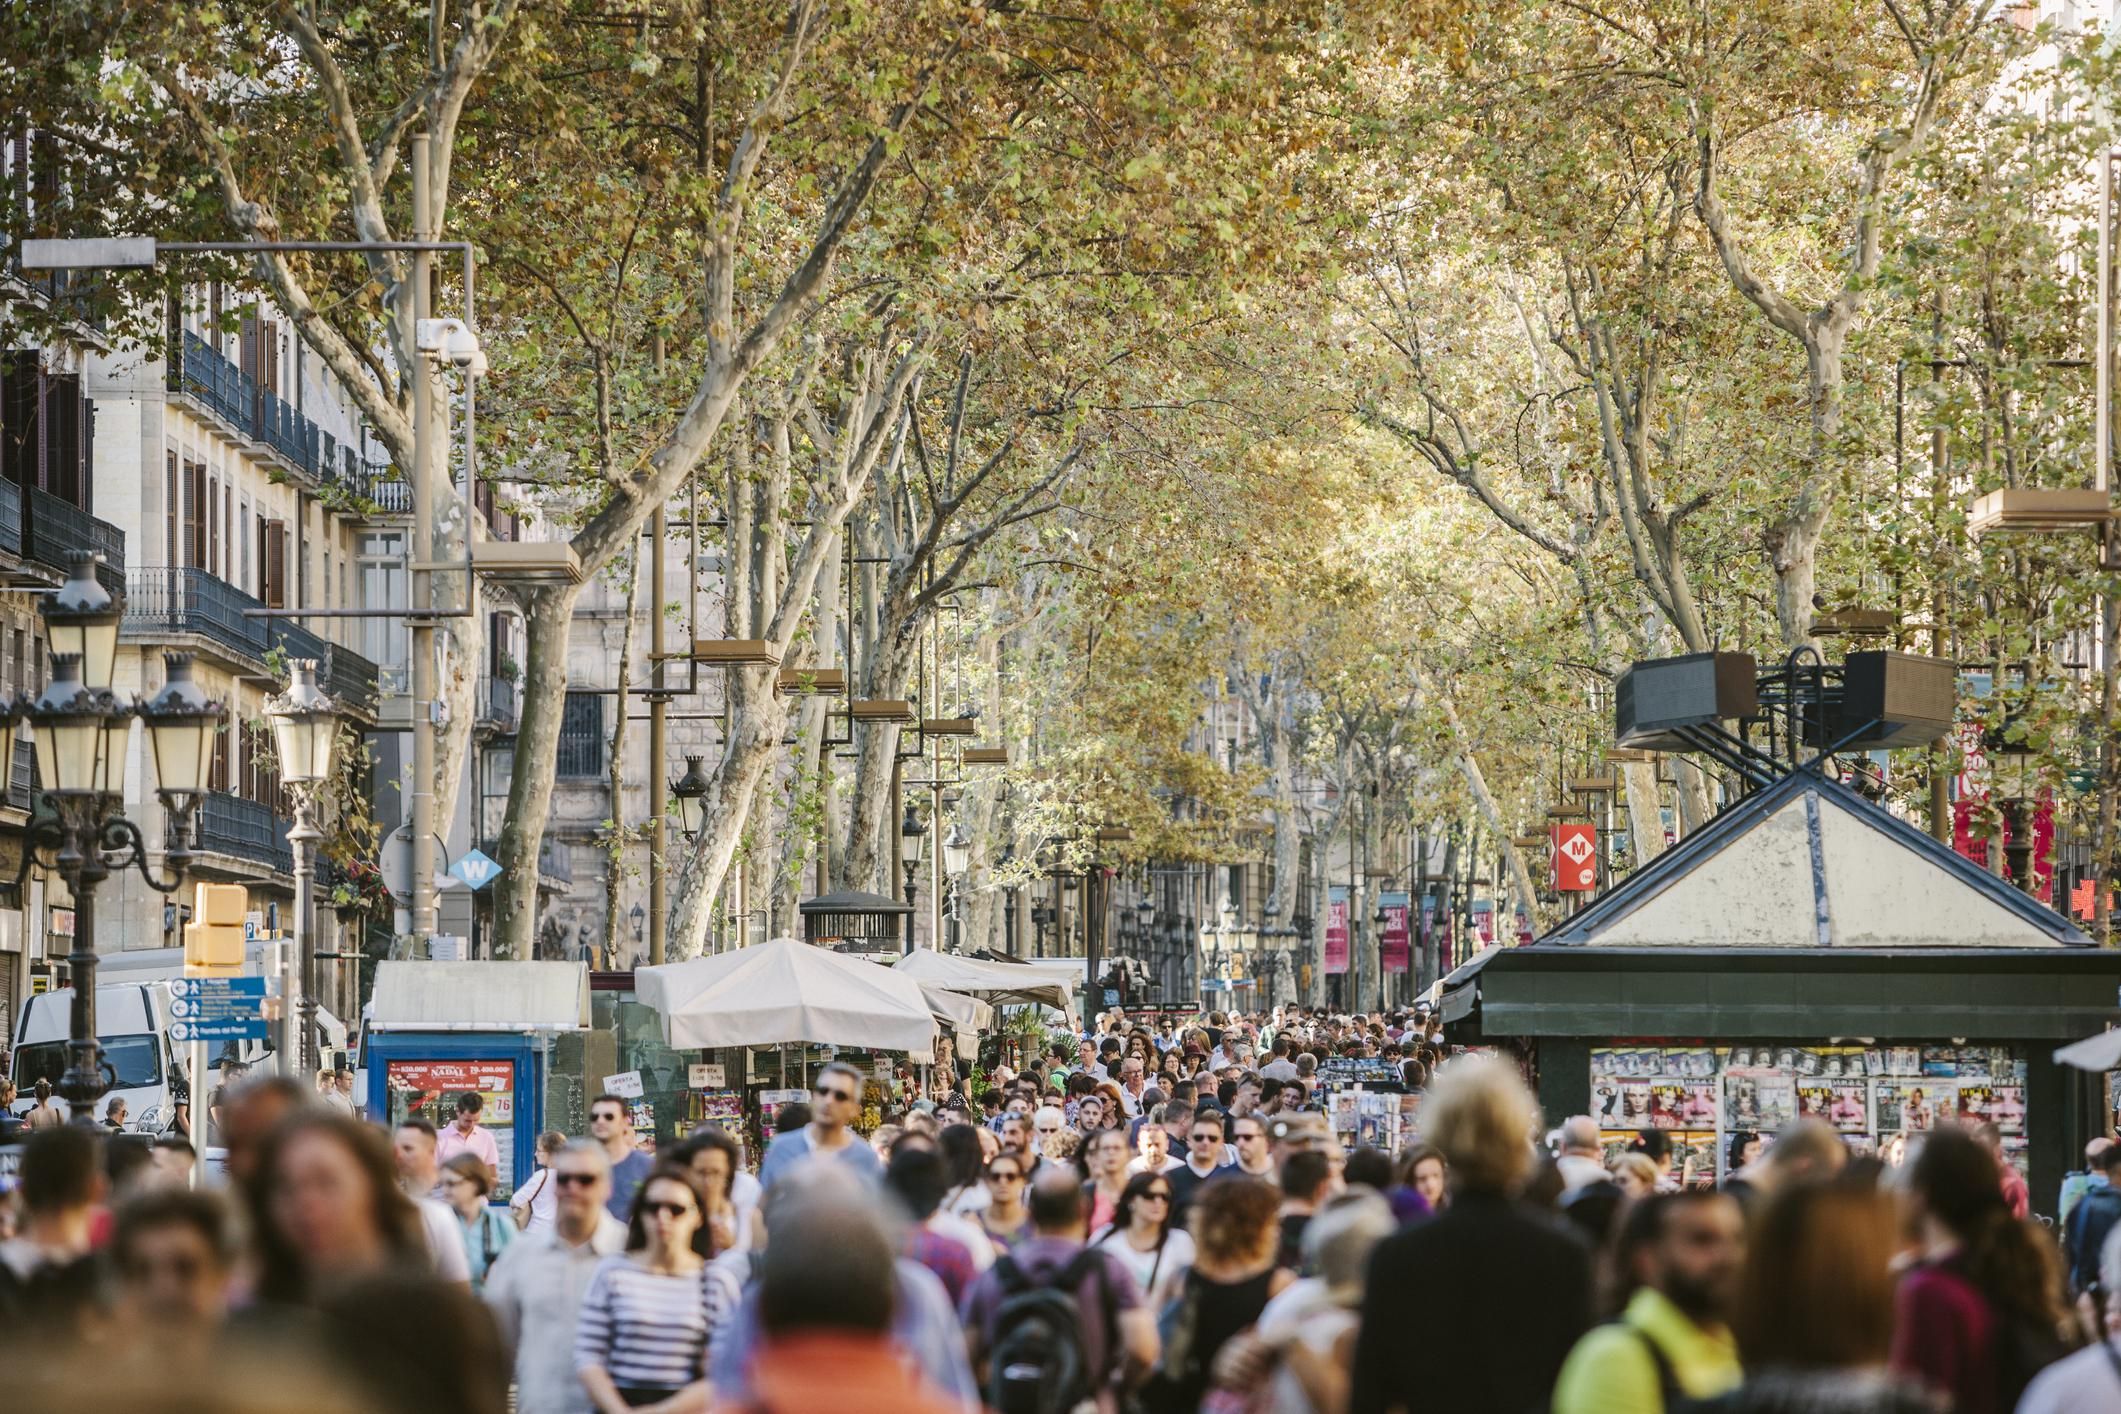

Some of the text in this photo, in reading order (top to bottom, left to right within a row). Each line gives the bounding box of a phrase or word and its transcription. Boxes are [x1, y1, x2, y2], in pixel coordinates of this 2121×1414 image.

[1572, 842, 1585, 855] M
[462, 861, 489, 880] W
[247, 923, 253, 938] P
[497, 1099, 510, 1110] 76
